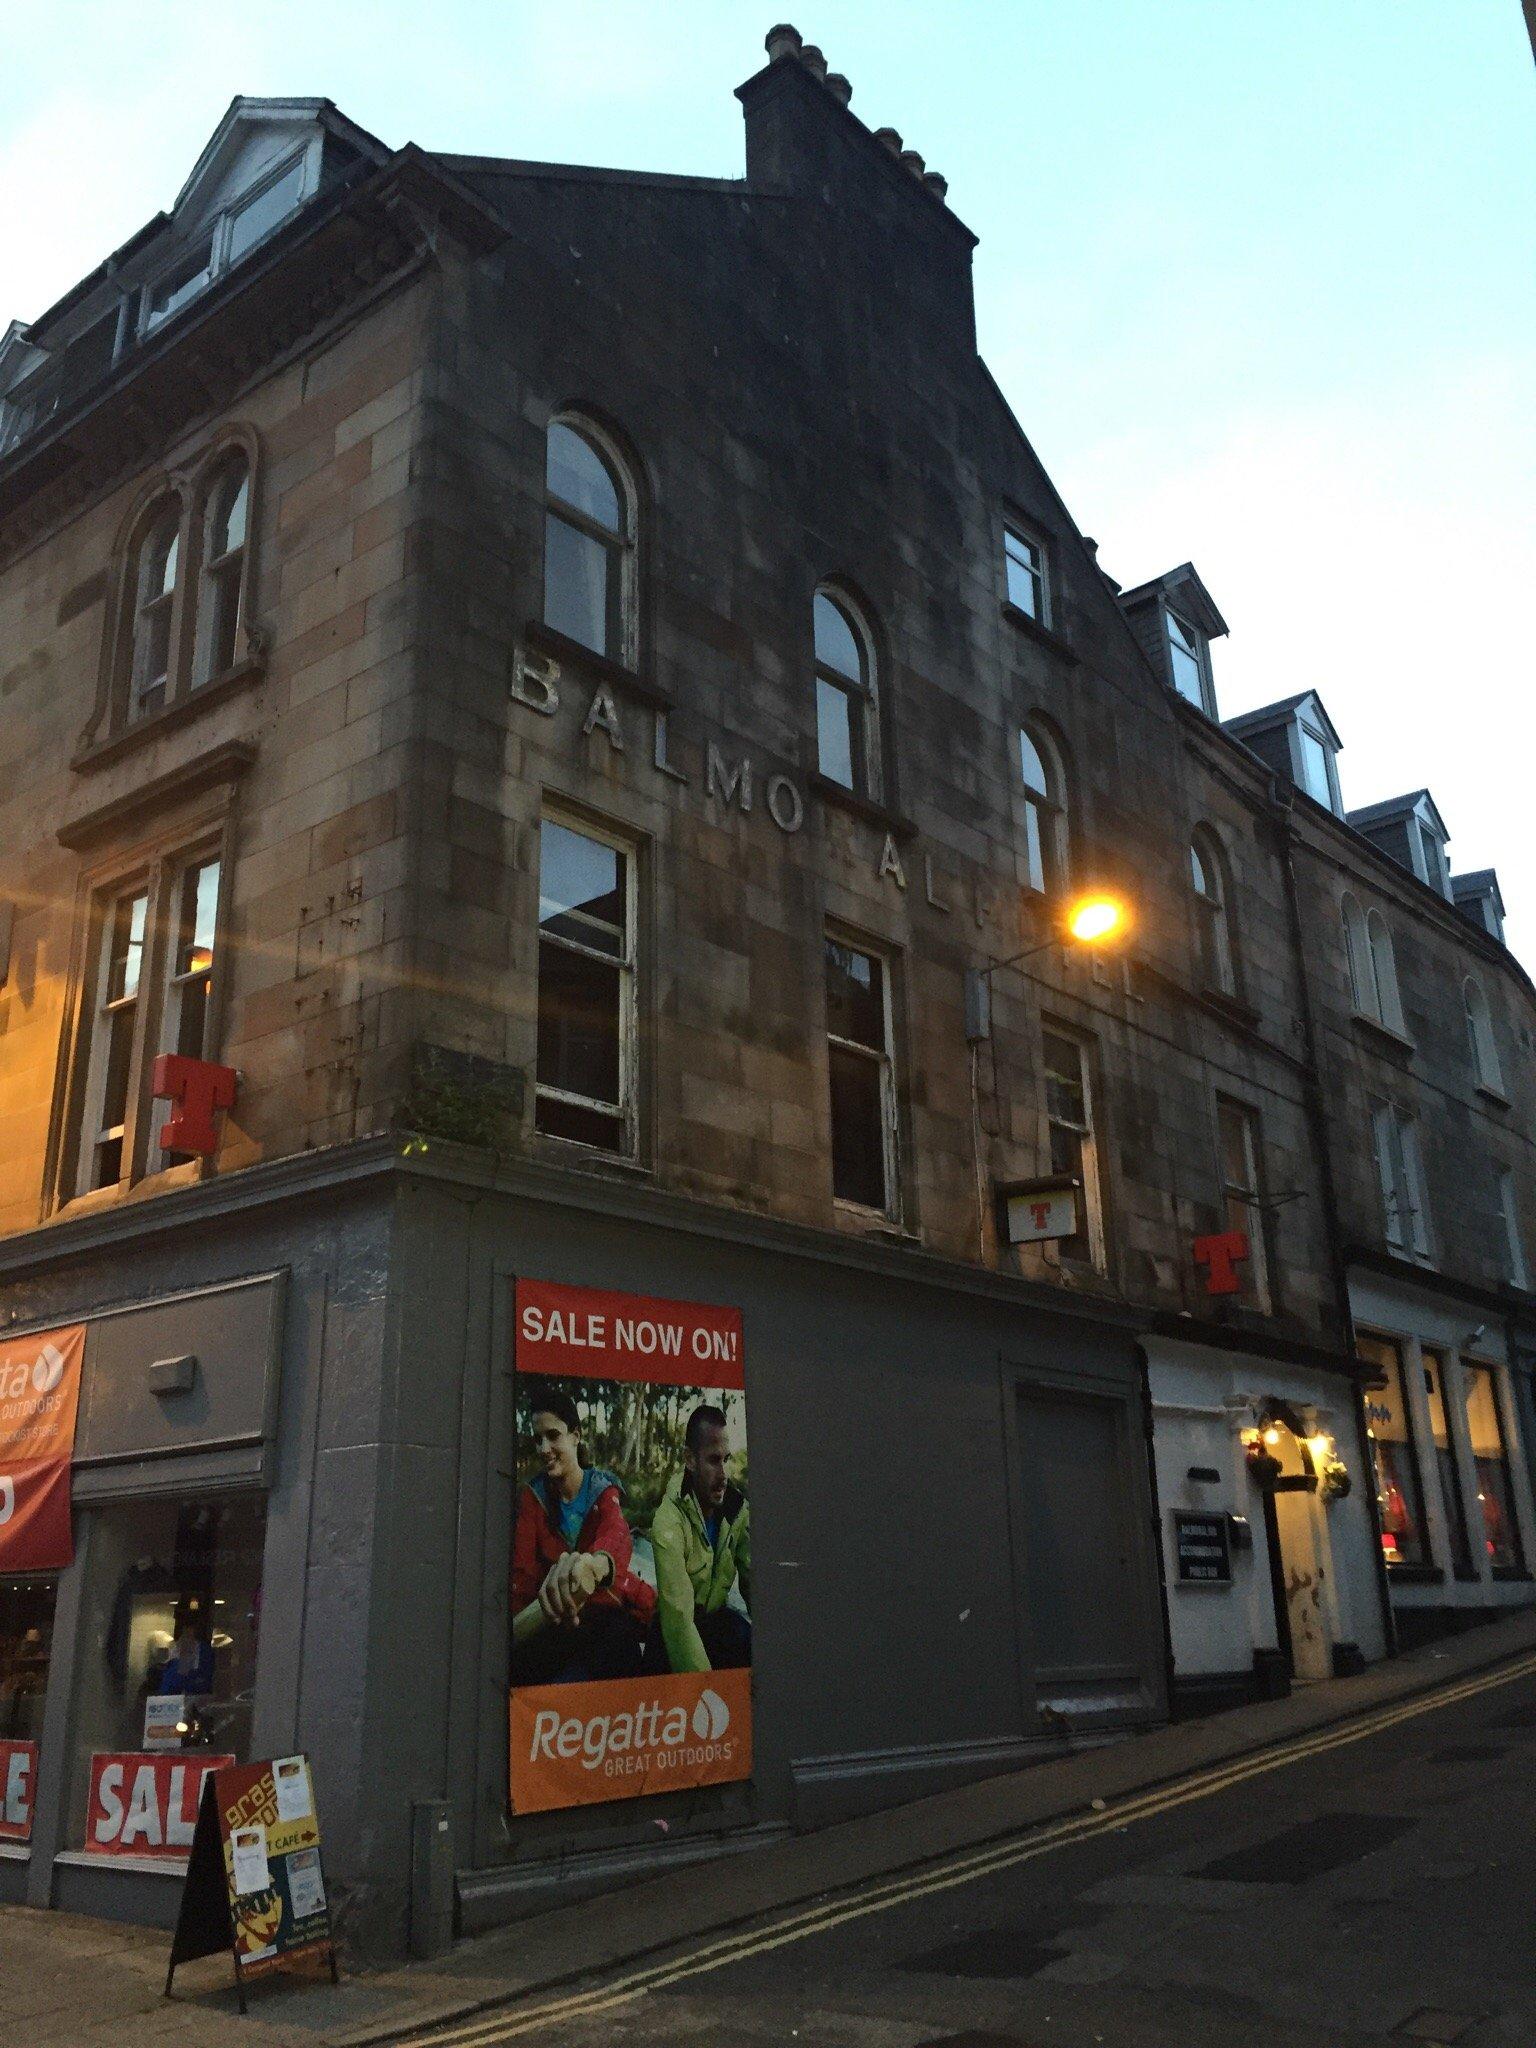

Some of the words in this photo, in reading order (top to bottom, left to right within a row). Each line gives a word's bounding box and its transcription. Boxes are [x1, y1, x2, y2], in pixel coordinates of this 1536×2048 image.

[153, 1054, 236, 1157] T
[1031, 1202, 1051, 1230] T
[1194, 1230, 1249, 1295] T
[522, 1306, 606, 1349] SALE
[615, 1318, 684, 1356] NOW
[692, 1327, 738, 1362] ON!
[530, 1700, 688, 1770] Regatta
[605, 1753, 652, 1778] GREAT
[657, 1742, 733, 1769] OUTDOORS
[0, 1752, 31, 1824] E
[95, 1763, 218, 1846] SAL
